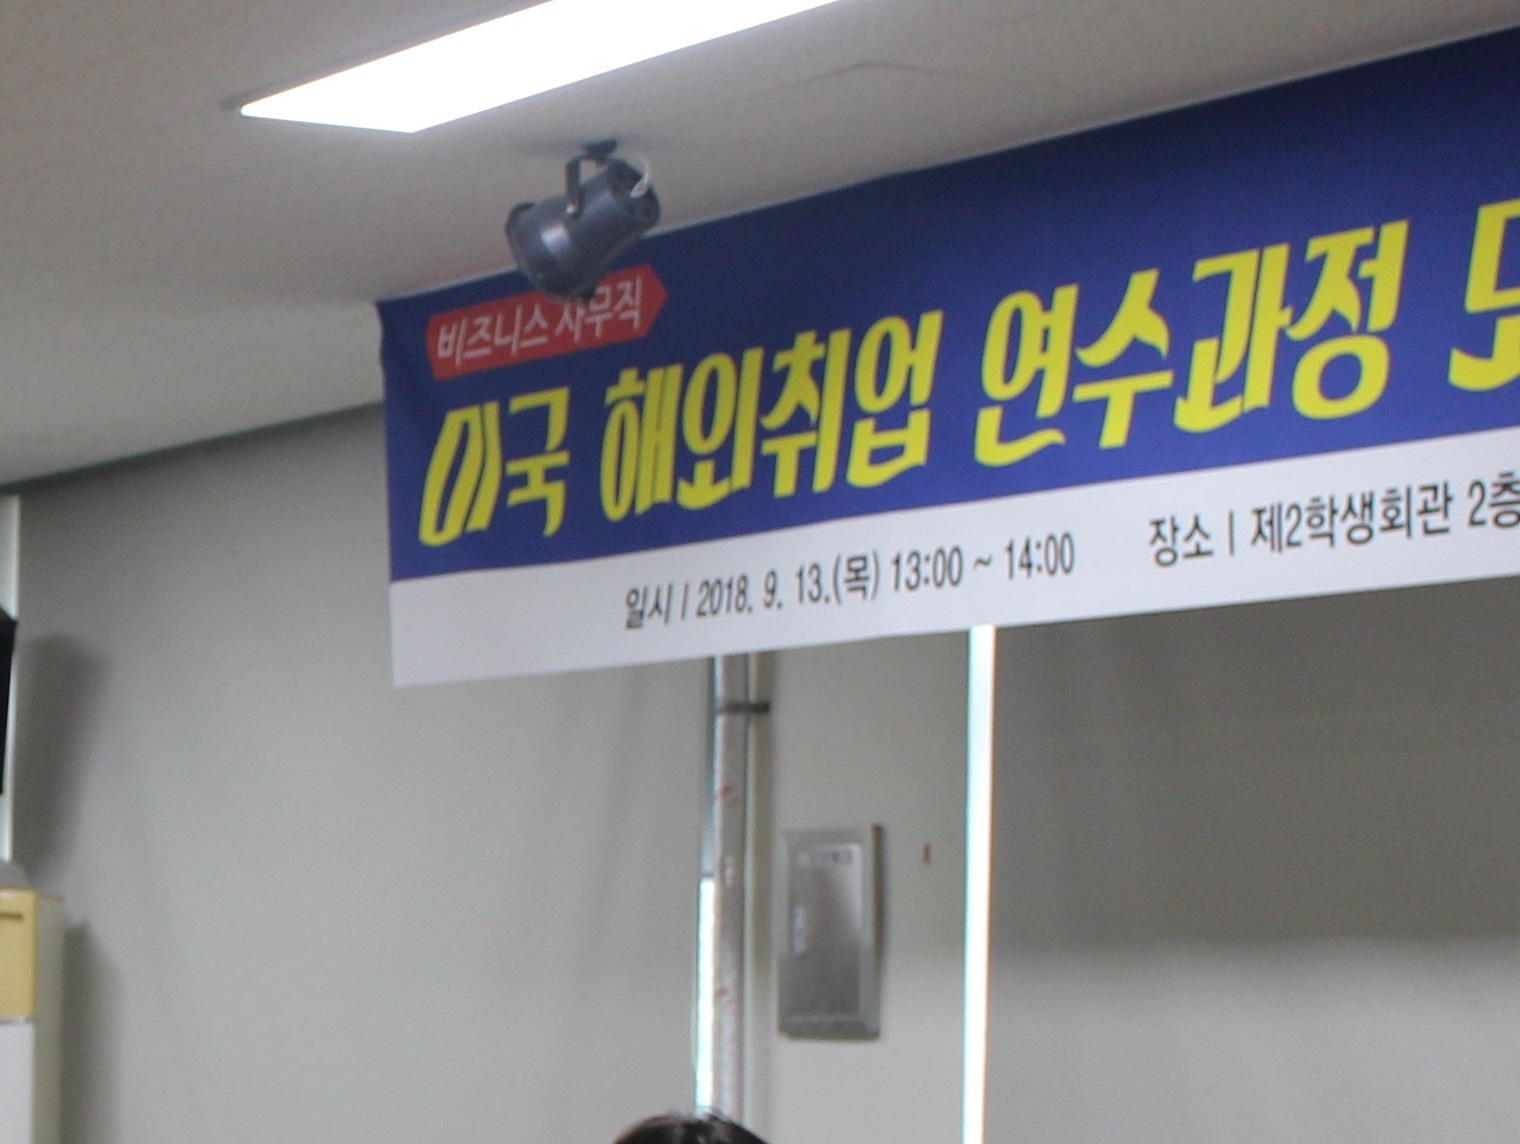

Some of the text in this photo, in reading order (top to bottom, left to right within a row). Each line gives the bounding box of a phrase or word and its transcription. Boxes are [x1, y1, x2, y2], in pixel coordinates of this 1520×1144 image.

[437, 276, 643, 367] 비즈니스 사무직
[418, 386, 571, 547] 미국
[599, 310, 944, 522] 해외취업
[974, 220, 1410, 468] 연수과정
[1150, 514, 1215, 568] 장소
[1250, 480, 1454, 555] 제2학생회관
[1468, 472, 1520, 528] 2층
[625, 582, 673, 631] 일시
[696, 574, 752, 618] 2018.
[763, 569, 783, 609] 9.
[891, 546, 963, 593] 13:00
[1004, 531, 1075, 580] 14:00
